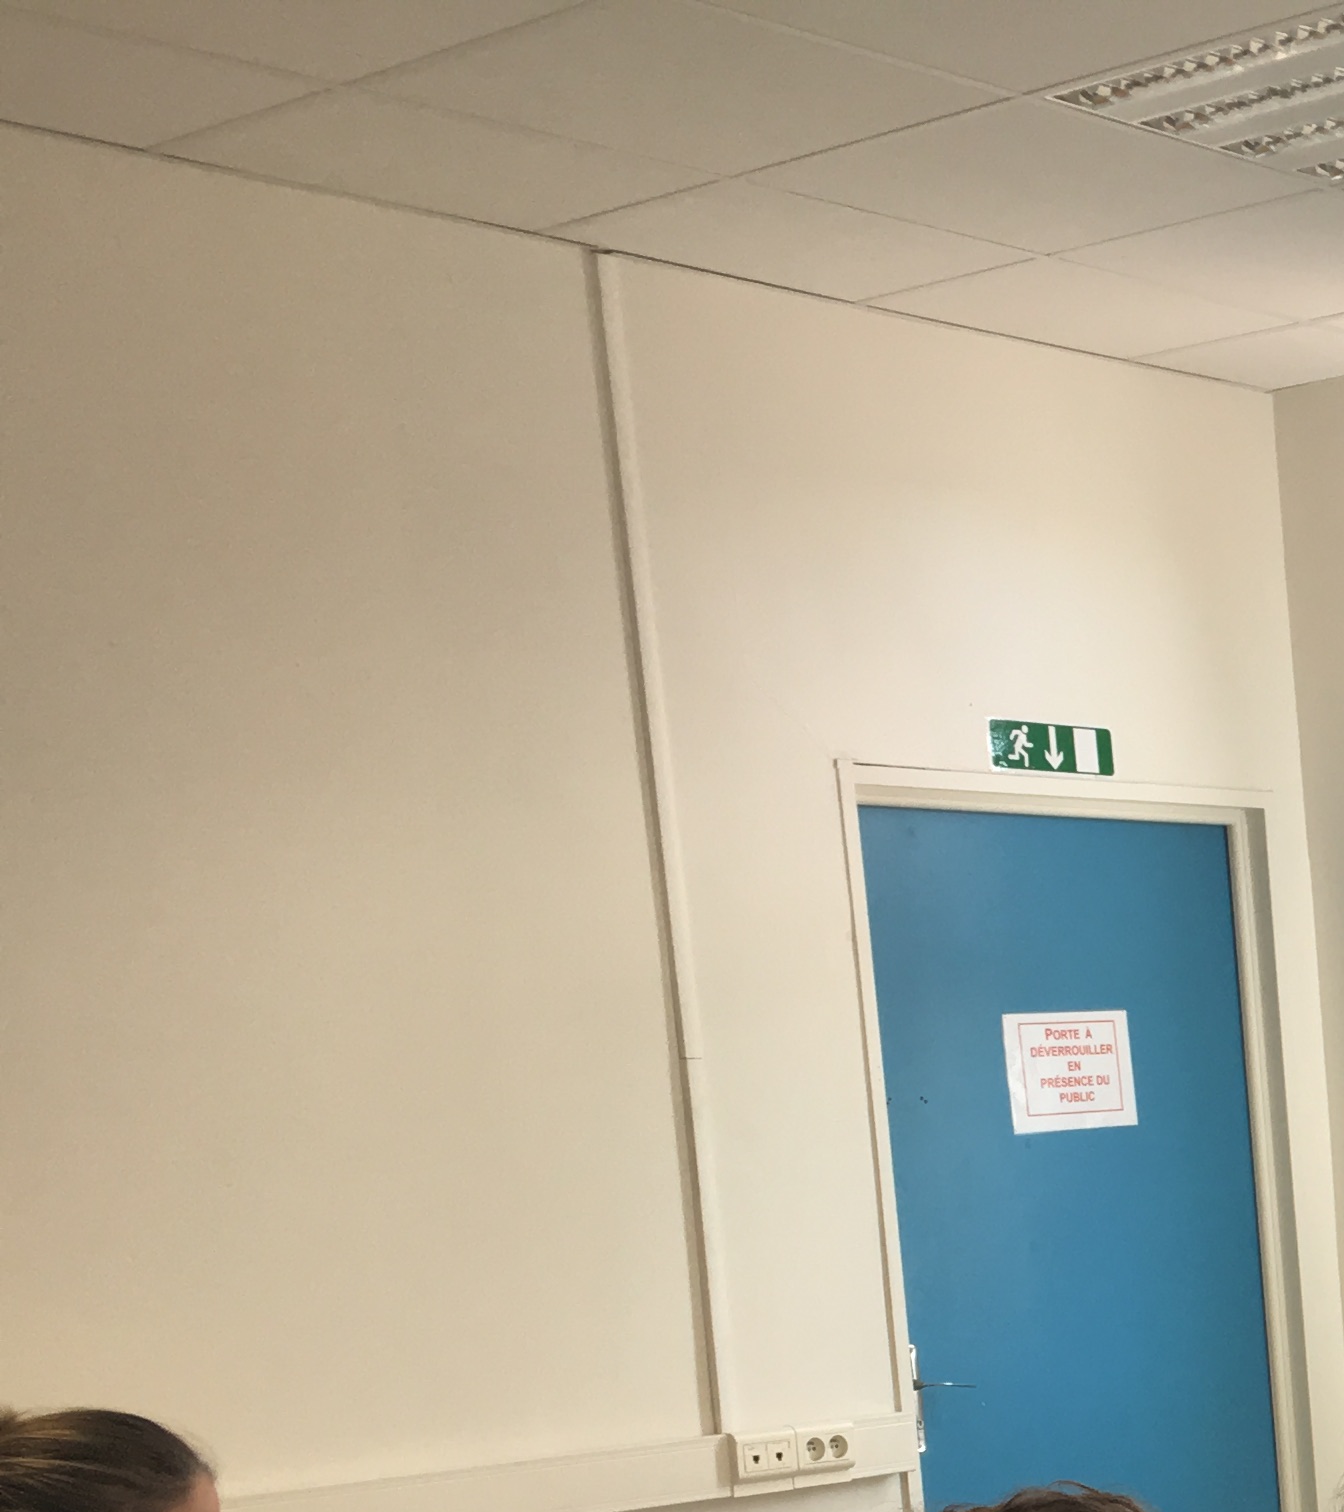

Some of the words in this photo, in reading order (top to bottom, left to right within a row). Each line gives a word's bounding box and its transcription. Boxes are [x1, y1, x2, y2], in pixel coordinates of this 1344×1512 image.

[1045, 1028, 1080, 1040] PORTE
[1030, 1044, 1113, 1057] DÉVERROUILLER
[1067, 1061, 1081, 1071] EN
[1041, 1075, 1094, 1088] PRÉSENCE
[1096, 1075, 1110, 1085] DU
[1059, 1091, 1095, 1103] PUBLIC
